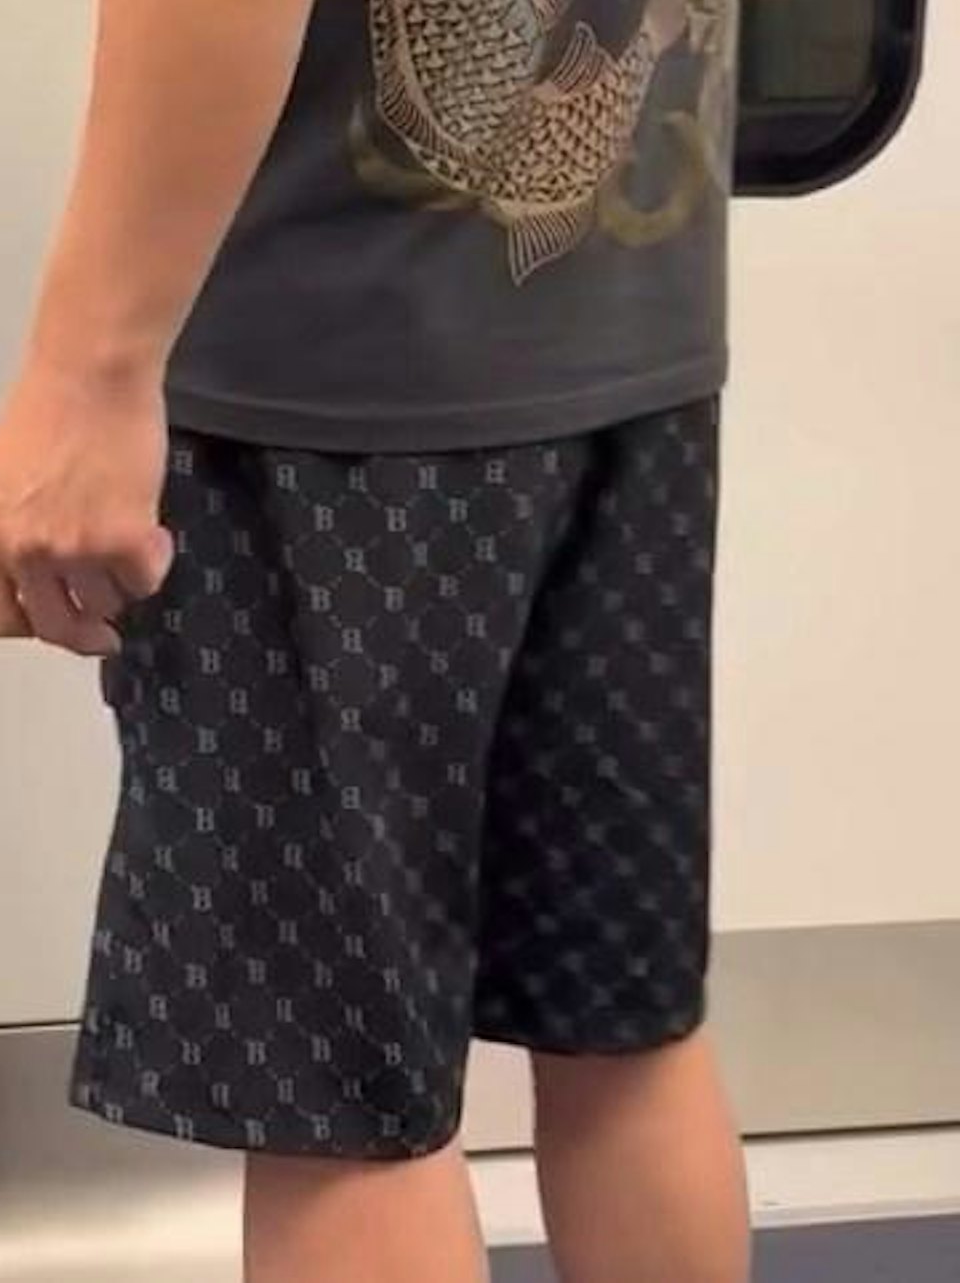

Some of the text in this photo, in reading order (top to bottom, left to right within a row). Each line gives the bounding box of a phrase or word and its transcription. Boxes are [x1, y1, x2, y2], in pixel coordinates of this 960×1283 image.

[384, 506, 407, 533] B
[195, 806, 215, 833] B
[190, 884, 213, 912] B
